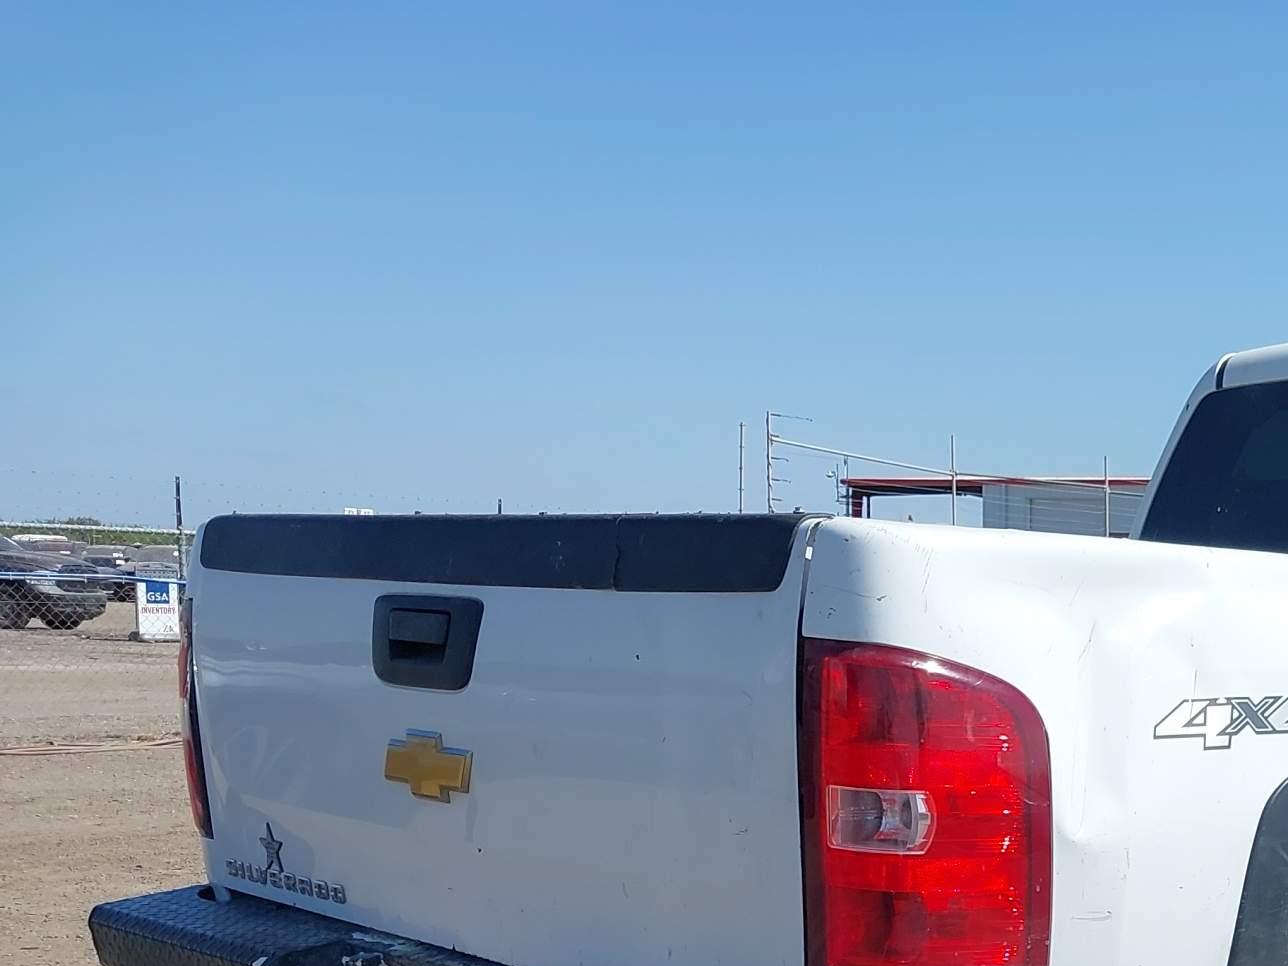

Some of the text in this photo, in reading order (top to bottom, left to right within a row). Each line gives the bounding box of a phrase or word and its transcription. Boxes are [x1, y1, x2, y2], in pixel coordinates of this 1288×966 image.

[147, 591, 169, 601] GSA
[141, 606, 176, 615] INVENTORY
[225, 858, 347, 905] SILVERADO
